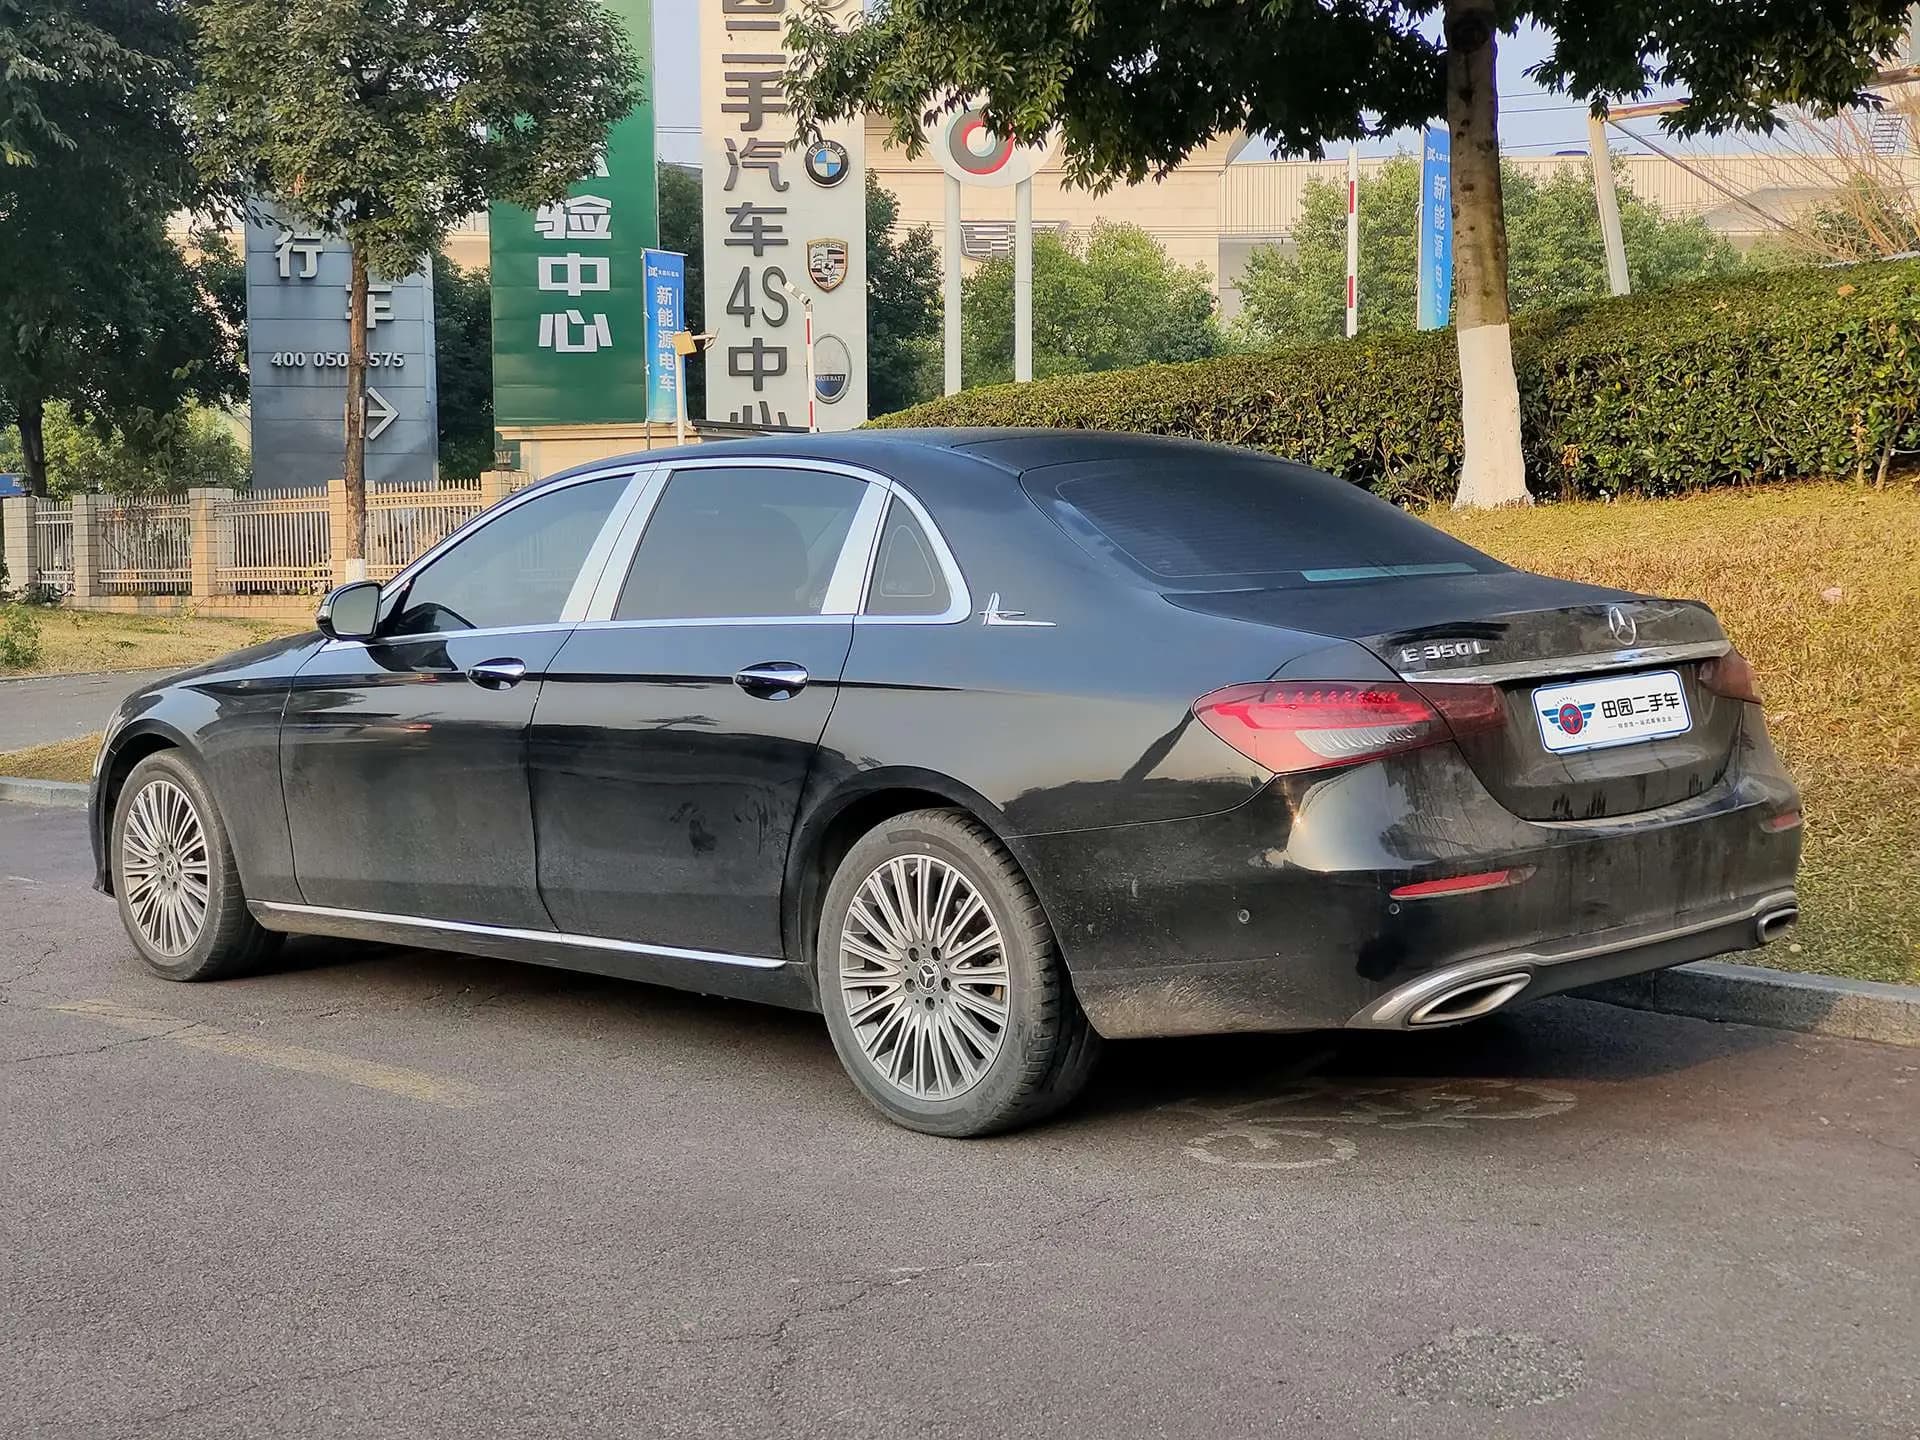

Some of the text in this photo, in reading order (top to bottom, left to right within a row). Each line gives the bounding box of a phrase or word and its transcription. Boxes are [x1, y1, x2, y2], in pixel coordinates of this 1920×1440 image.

[809, 141, 846, 156] BMW
[721, 0, 791, 427] 二手汽车4S中
[274, 230, 324, 278] 行
[656, 285, 676, 393] 新能源电车
[271, 352, 405, 367] 400 050 575
[1401, 648, 1420, 662] E
[1601, 691, 1680, 718] 田园二手车
